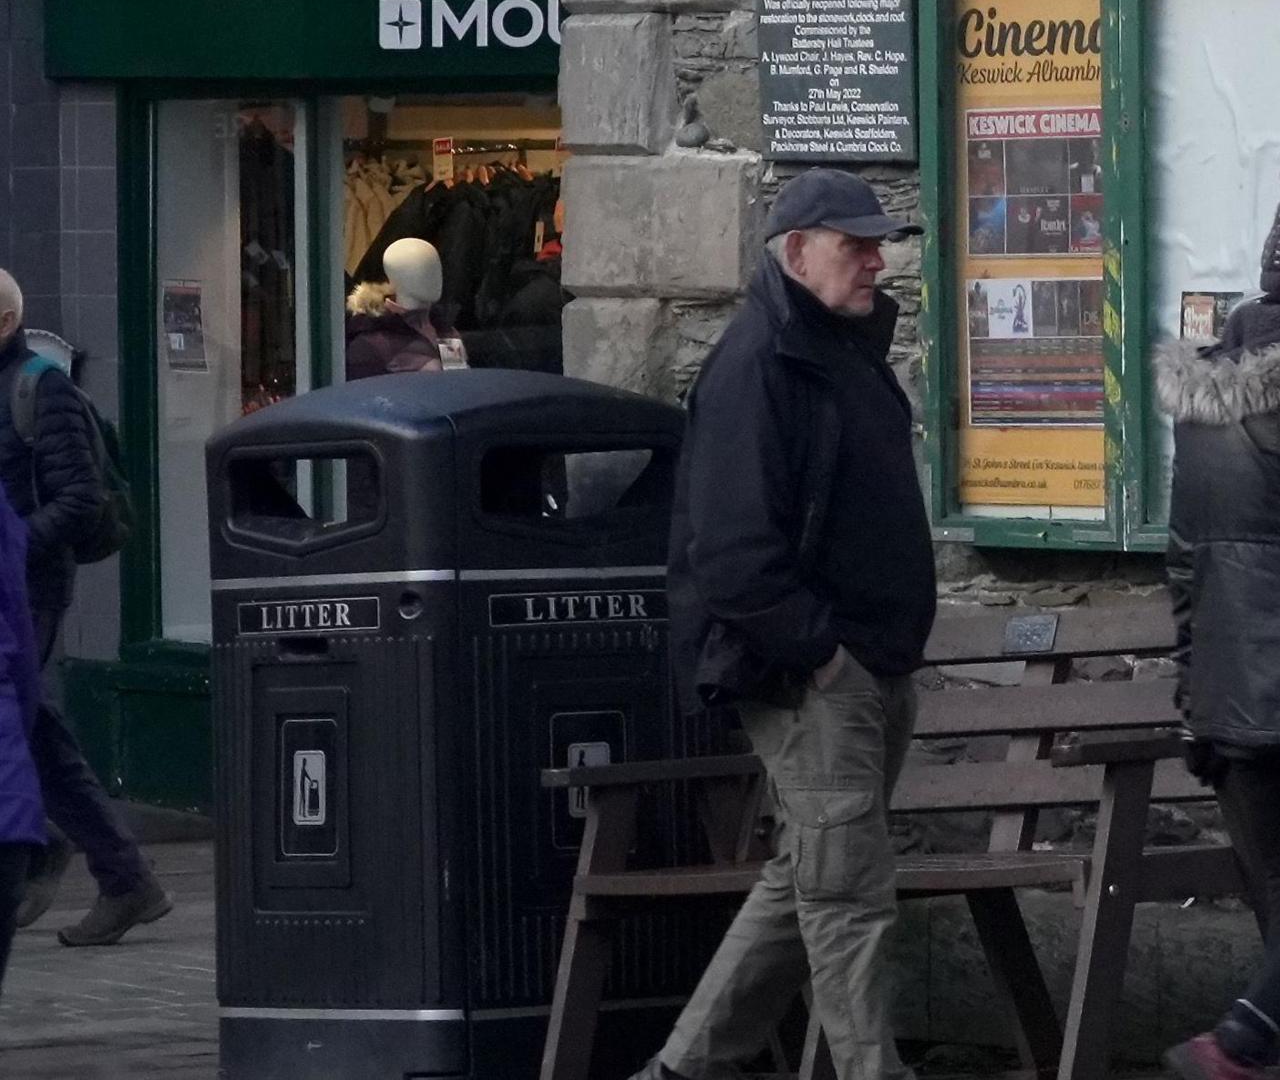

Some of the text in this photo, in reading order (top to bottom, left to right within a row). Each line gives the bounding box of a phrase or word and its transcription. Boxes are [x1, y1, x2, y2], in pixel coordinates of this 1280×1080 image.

[764, 0, 780, 9] Was
[829, 78, 839, 86] on
[958, 61, 1023, 85] Keswick
[826, 89, 841, 100] May
[969, 114, 1100, 136] KESWICK CINEMA
[261, 602, 352, 631] LITTER
[525, 594, 648, 622] LITTER
